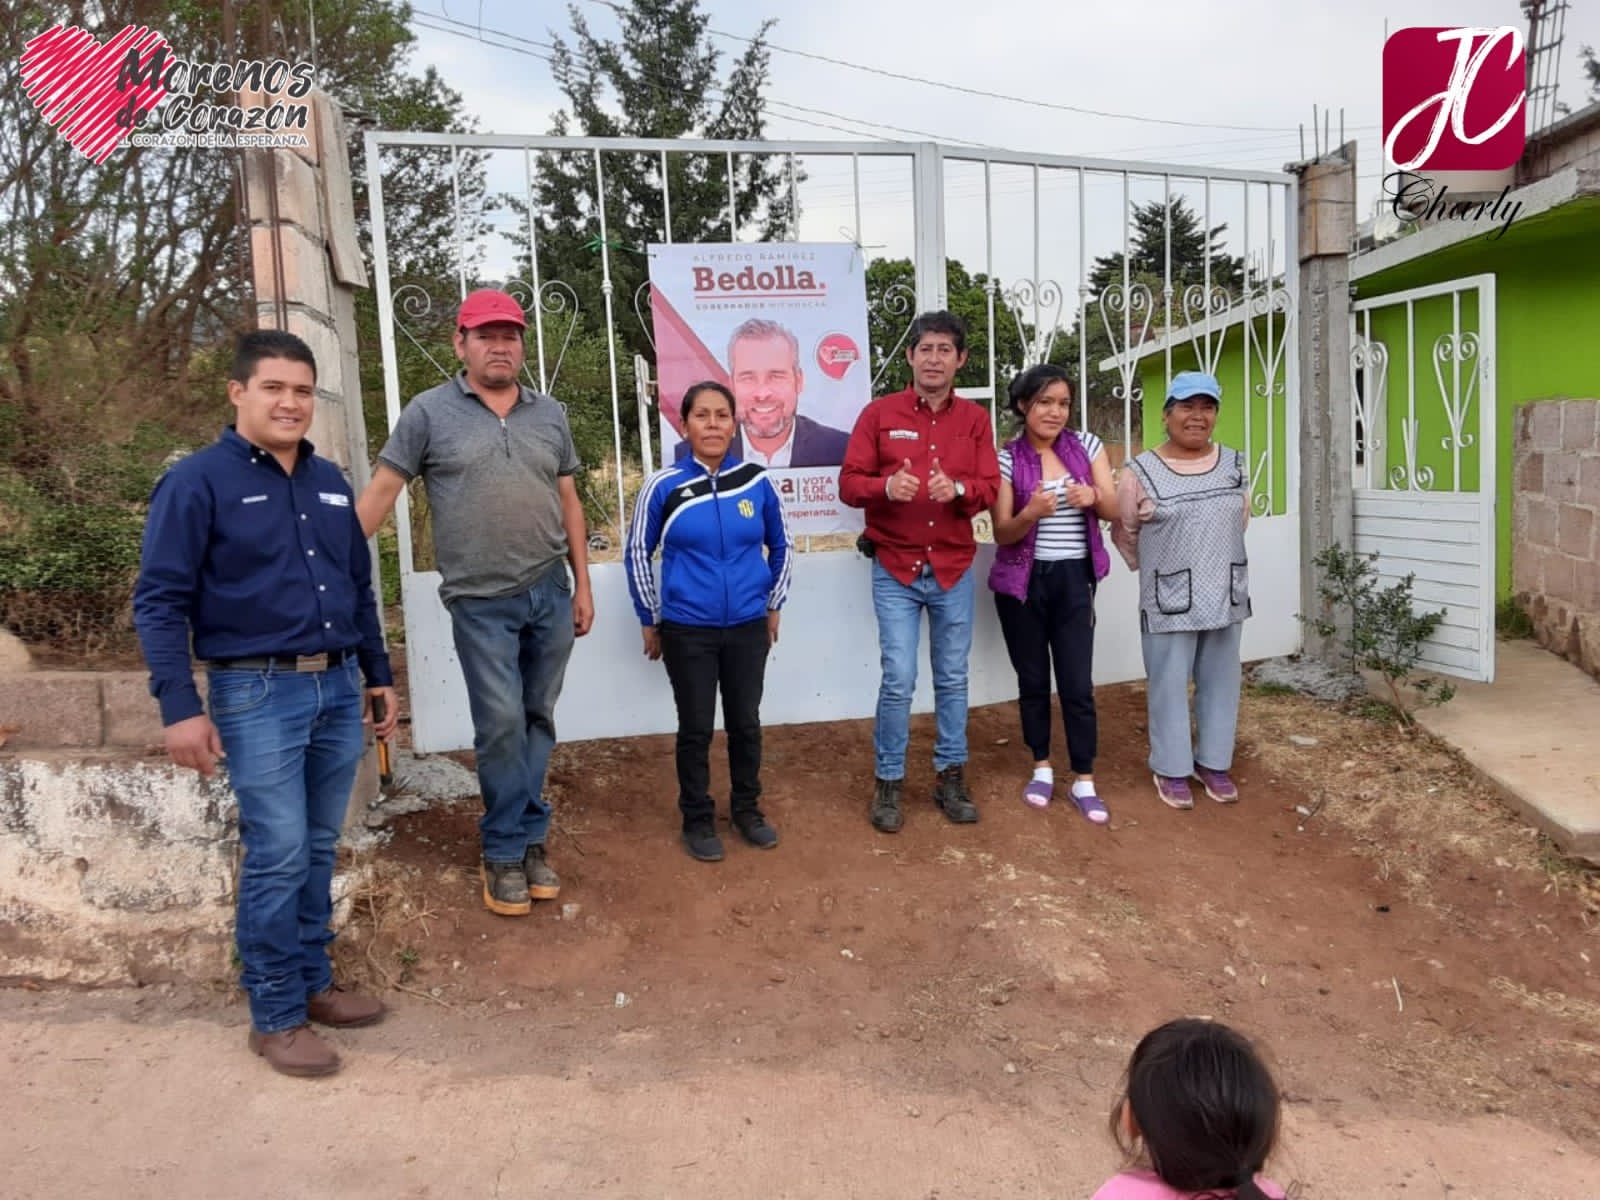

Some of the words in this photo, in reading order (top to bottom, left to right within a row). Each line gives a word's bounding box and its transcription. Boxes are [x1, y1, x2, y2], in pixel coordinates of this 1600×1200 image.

[693, 252, 753, 262] ALFREDO
[803, 476, 833, 485] VOTA
[803, 486, 809, 494] 6
[812, 485, 826, 494] DE
[803, 493, 835, 503] JUNIO
